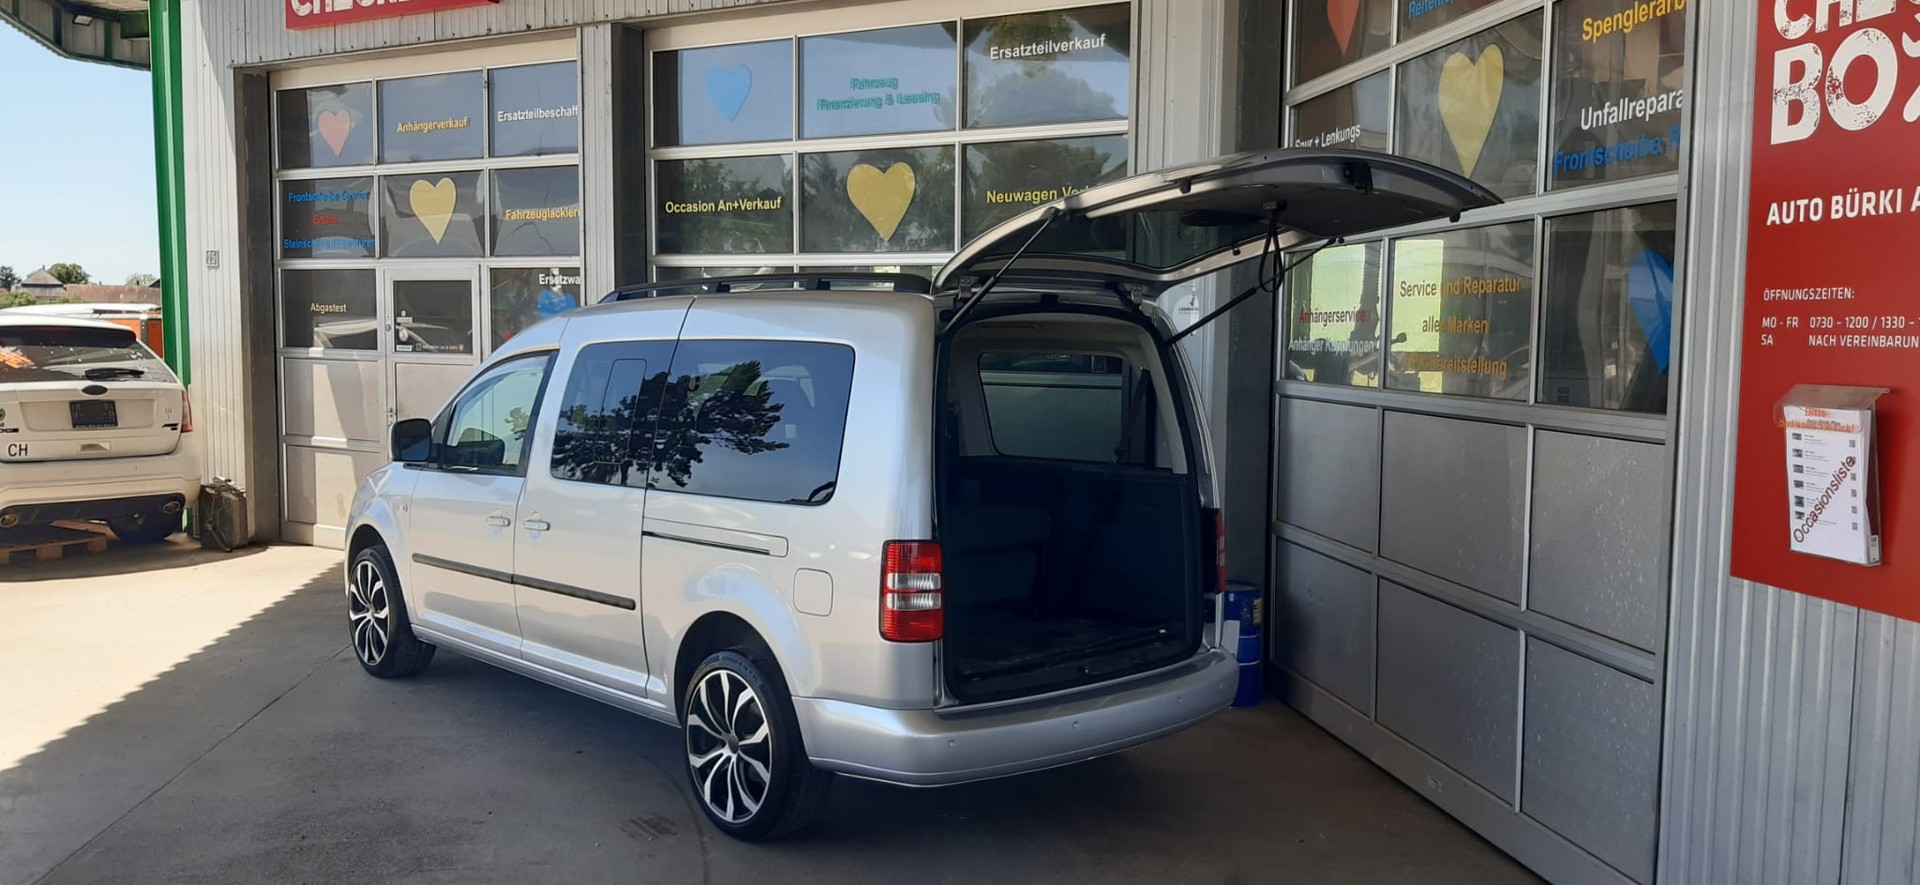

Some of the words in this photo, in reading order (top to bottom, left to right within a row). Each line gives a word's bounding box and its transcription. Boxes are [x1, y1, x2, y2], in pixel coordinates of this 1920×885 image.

[990, 34, 1106, 60] Ersatzteilverkauf
[849, 77, 899, 90] Fahrzeug
[816, 97, 882, 111] Finanzierung
[885, 93, 894, 106] &
[897, 91, 940, 105] Leasing
[1581, 89, 1683, 131] Unfallrepara
[497, 105, 579, 122] Ersatzteilbeschaff
[396, 116, 469, 133] Anhängerverkauf
[1321, 124, 1361, 147] Lenkungs
[1554, 134, 1662, 173] Frontscheibe
[986, 189, 1058, 205] Neuwagen
[1062, 185, 1090, 197] Ve
[665, 200, 715, 213] Occasion
[717, 197, 782, 212] An+Verkauf
[1766, 197, 1823, 226] AUTO
[1831, 187, 1903, 220] BÜRKI
[539, 273, 580, 285] Ersatzwa
[1400, 280, 1437, 297] Service
[1463, 276, 1521, 298] Reparatur
[1763, 287, 1855, 301] ÖFFNUNGSZEITEN:
[310, 302, 347, 314] Abgastest
[1299, 308, 1366, 327] Anhängerservice
[1447, 315, 1490, 334] Marken
[1762, 316, 1777, 329] MO
[1786, 316, 1799, 329] FR
[1809, 316, 1834, 329] 0730
[1845, 316, 1869, 329] 1200
[1872, 316, 1878, 330] /
[1881, 316, 1905, 329] 1330
[1288, 337, 1323, 355] Anhänger
[1761, 334, 1774, 346] SA
[1809, 335, 1837, 347] NACH
[8, 443, 28, 457] CH
[1793, 456, 1855, 543] Occasionsliste
